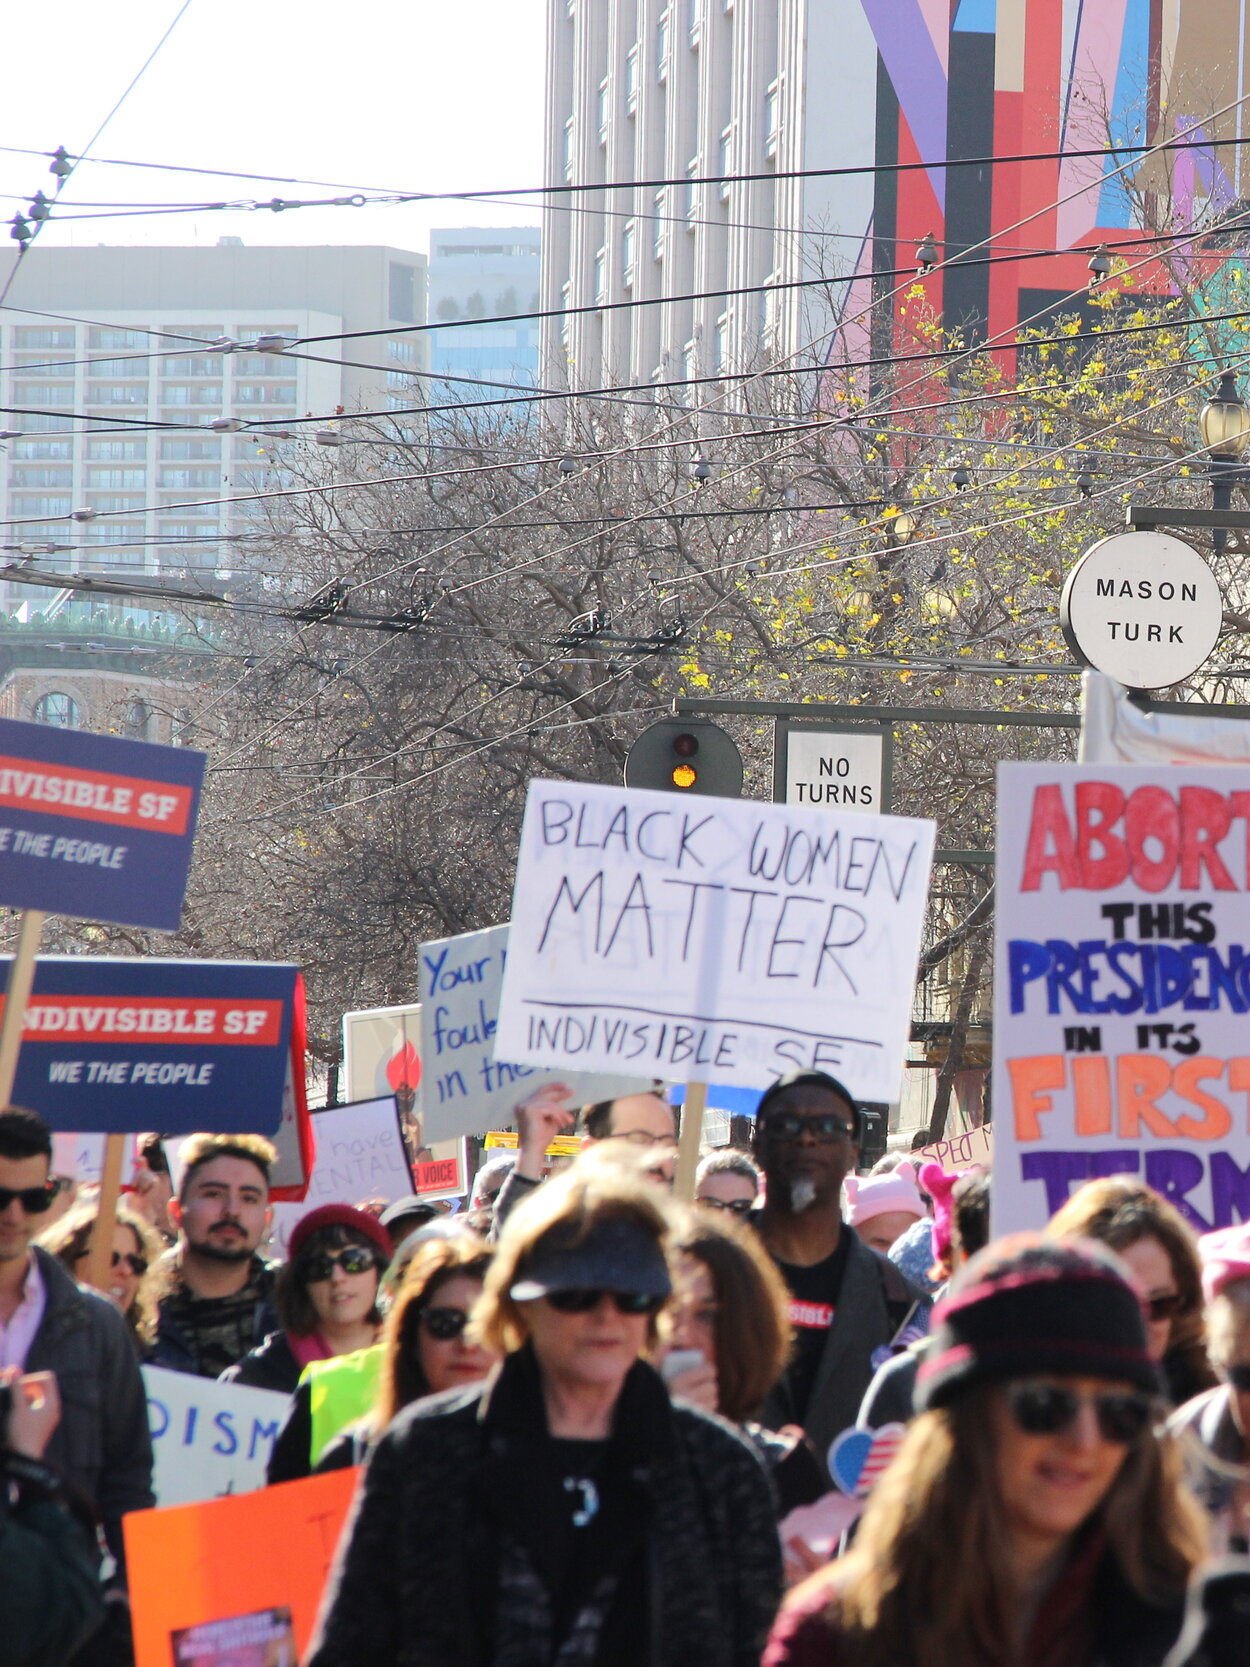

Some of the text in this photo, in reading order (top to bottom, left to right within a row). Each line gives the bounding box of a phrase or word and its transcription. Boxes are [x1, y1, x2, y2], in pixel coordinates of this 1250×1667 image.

[1096, 578, 1197, 602] MASON
[1107, 621, 1184, 644] TURK
[819, 757, 850, 777] NO
[137, 792, 179, 821] SF
[795, 783, 872, 805] TURNS
[13, 830, 53, 858] THE
[51, 836, 129, 869] PEOPLE
[541, 800, 918, 904] BLACK WOMEN
[537, 870, 867, 996] MATTER
[1101, 902, 1217, 943] THIS
[423, 948, 491, 998] Your
[223, 1010, 267, 1035] SF
[527, 1014, 738, 1068] INDIVISIBLE
[1064, 1023, 1201, 1055] IN ITS
[49, 1061, 216, 1085] WE THE PEOPLE
[437, 1069, 468, 1103] in
[423, 1162, 454, 1183] VOICE
